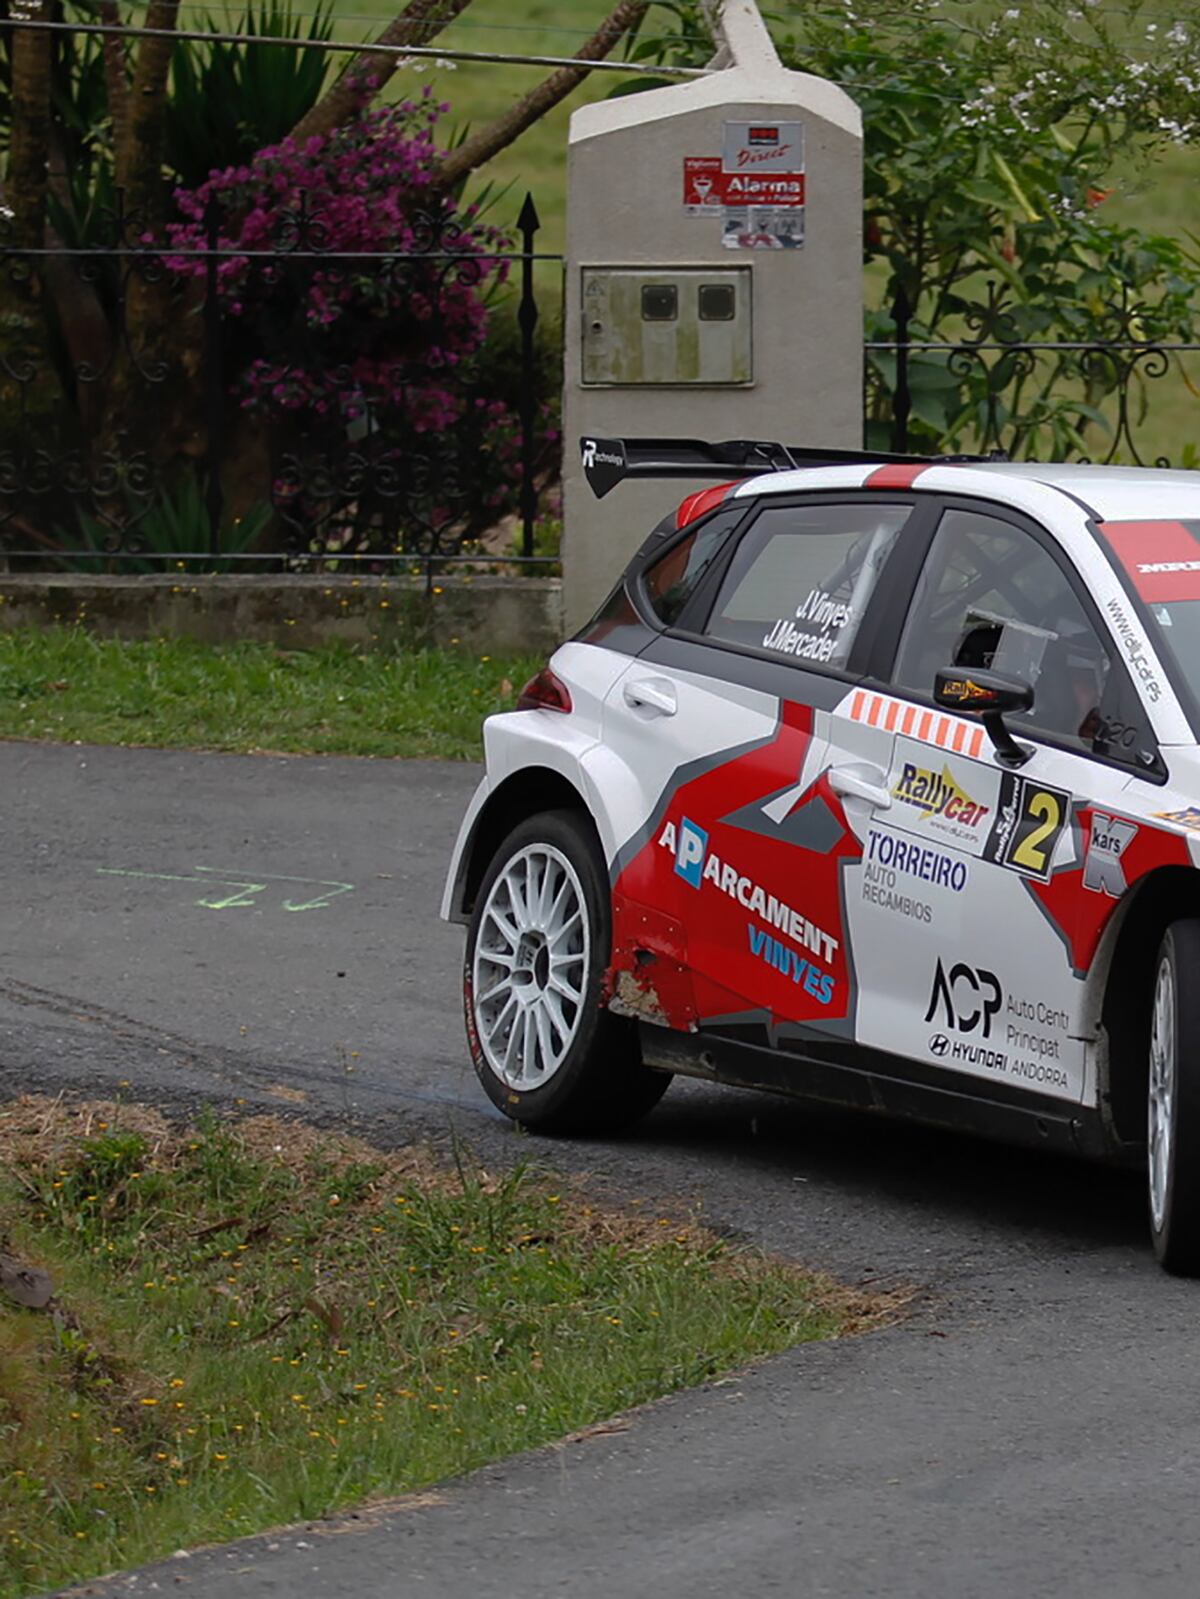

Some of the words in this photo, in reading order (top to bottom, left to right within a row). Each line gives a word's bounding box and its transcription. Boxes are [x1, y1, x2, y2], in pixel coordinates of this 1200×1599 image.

[727, 177, 800, 192] Alarma
[796, 590, 852, 628] J.Vinyes
[762, 619, 838, 663] J.Mercader
[1013, 792, 1060, 871] 2
[1092, 827, 1121, 854] kars
[864, 863, 897, 888] AUTO
[868, 830, 967, 892] TORREIRO
[862, 882, 932, 924] RECAMBIOS
[748, 923, 835, 1005] VINYES
[1006, 995, 1036, 1021] Auto
[1007, 1024, 1061, 1060] Principat
[952, 1041, 1008, 1071] HYUNDAI
[1011, 1057, 1069, 1089] ANDORRA
